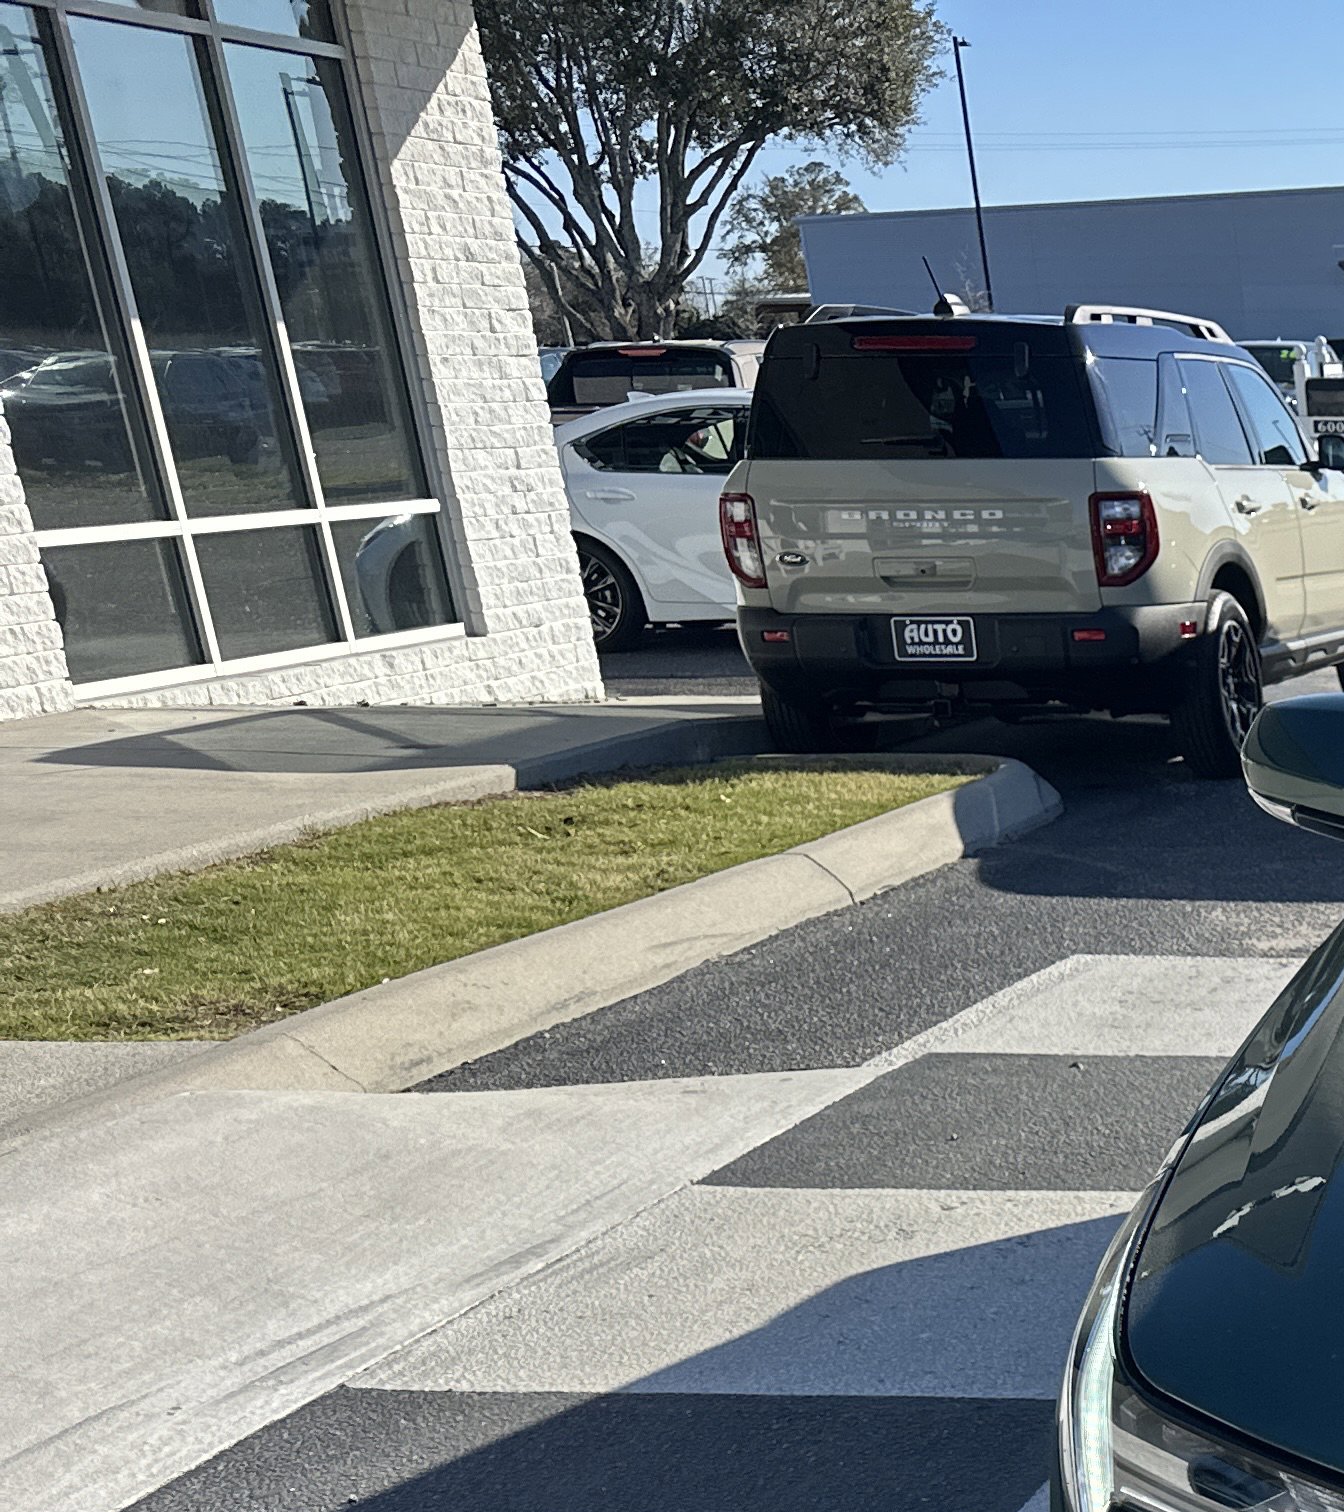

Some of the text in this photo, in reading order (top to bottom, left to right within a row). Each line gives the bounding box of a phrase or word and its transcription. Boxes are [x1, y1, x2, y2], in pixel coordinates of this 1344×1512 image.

[841, 510, 1003, 520] BRONCO
[904, 623, 962, 644] AUTO
[905, 644, 964, 655] WHOLESALE
